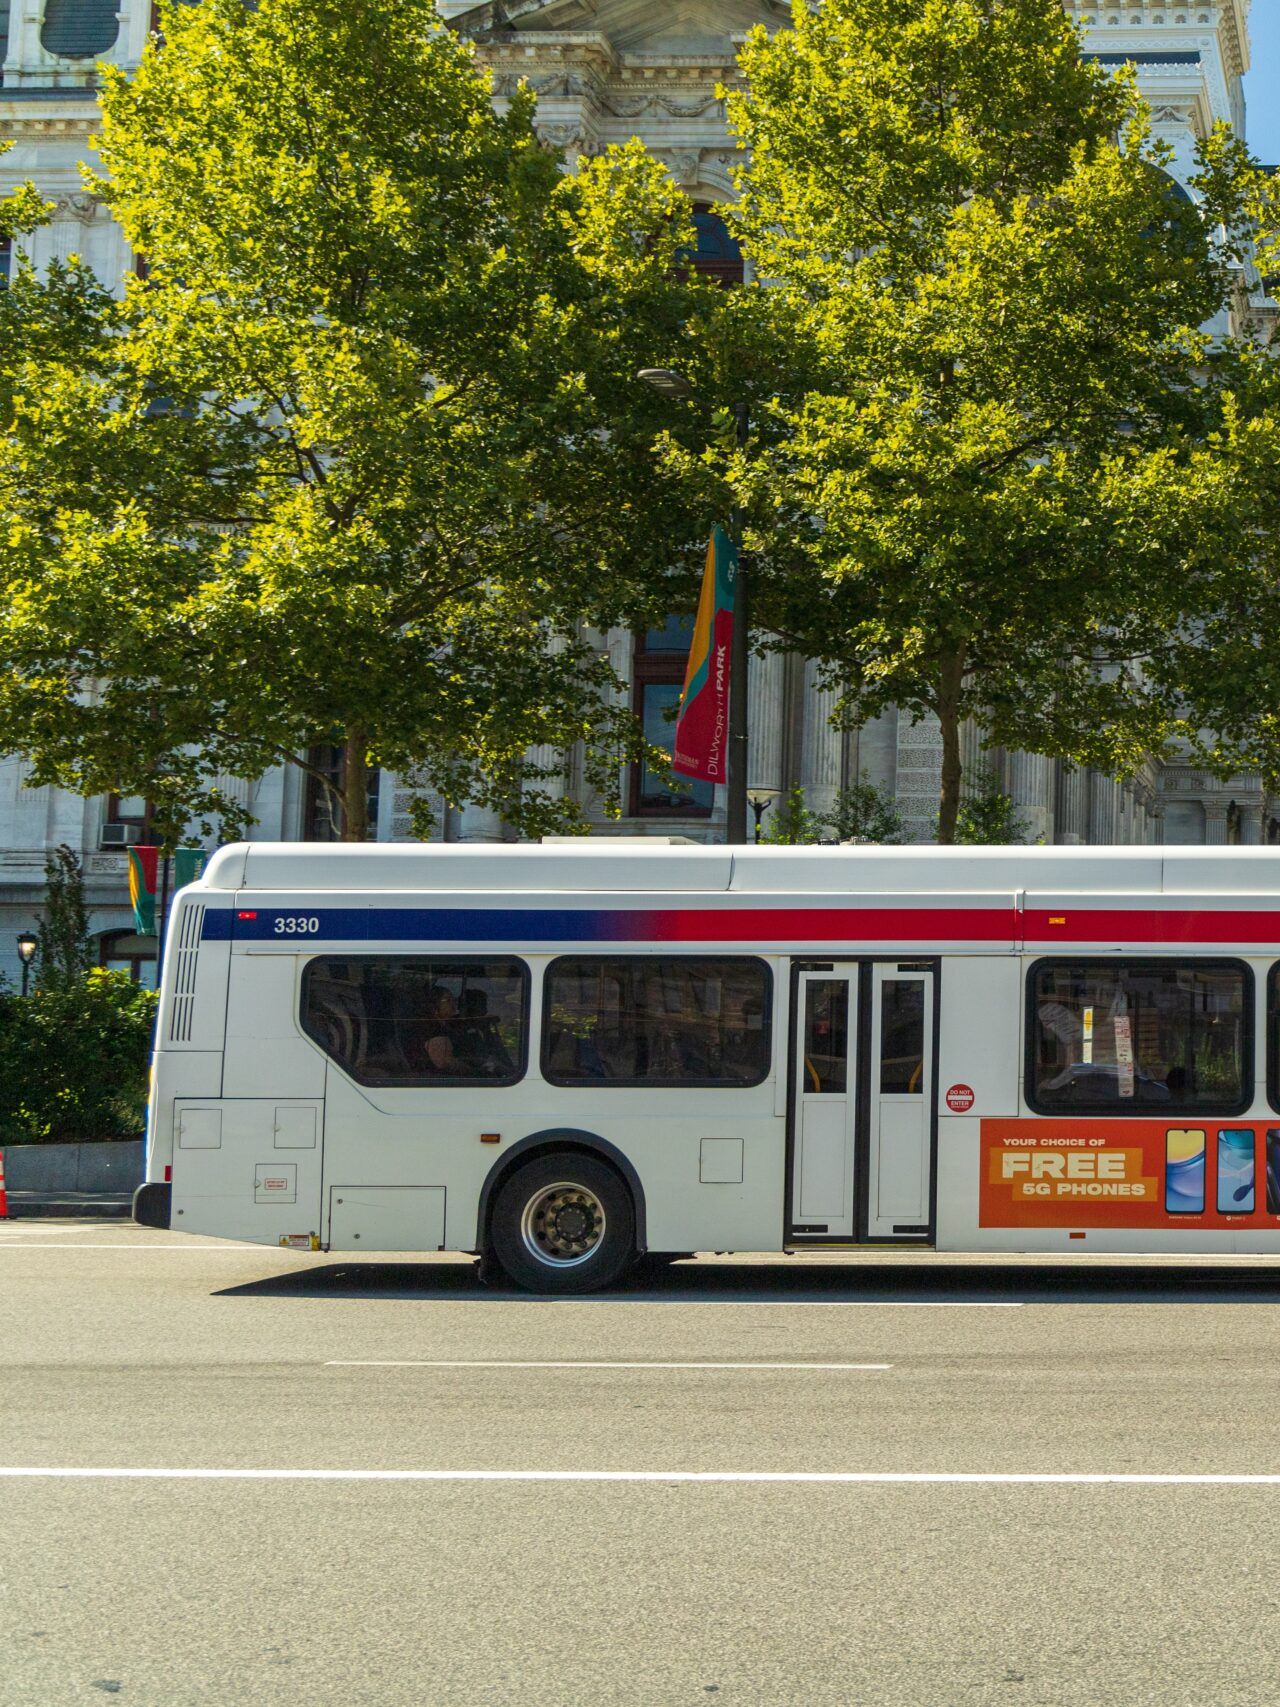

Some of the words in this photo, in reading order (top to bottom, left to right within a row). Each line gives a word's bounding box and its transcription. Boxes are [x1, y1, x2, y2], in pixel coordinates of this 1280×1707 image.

[716, 645, 726, 692] PARK
[274, 917, 320, 933] 3330
[1003, 1138, 1037, 1146] YOUR
[1040, 1138, 1086, 1147] CHOICE
[1089, 1138, 1106, 1147] OF
[1002, 1152, 1126, 1179] FREE
[1022, 1183, 1051, 1195] 5G
[1056, 1183, 1146, 1196] PHONES
